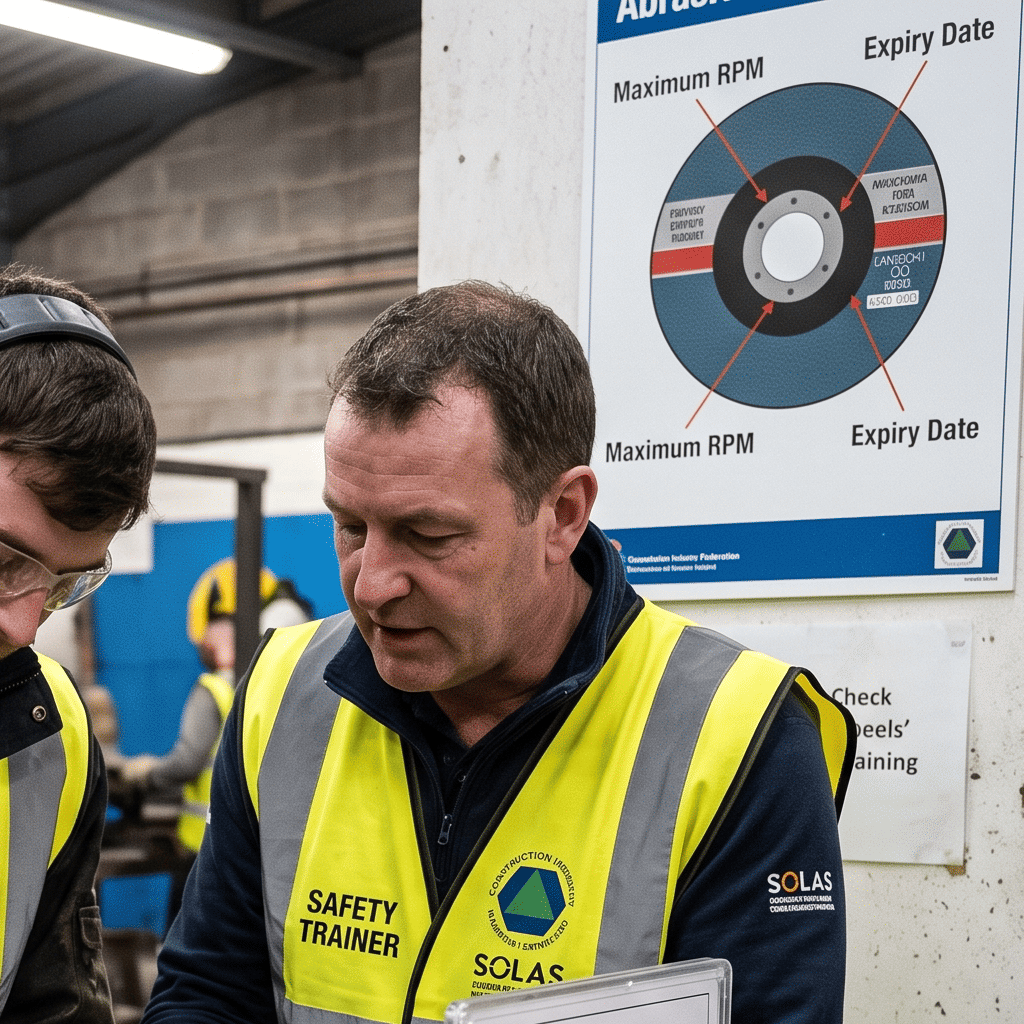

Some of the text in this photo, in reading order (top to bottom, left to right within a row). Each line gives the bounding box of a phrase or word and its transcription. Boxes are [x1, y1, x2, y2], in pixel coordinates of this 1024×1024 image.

[864, 17, 995, 61] Expiry Date
[614, 56, 764, 103] Maximum RPM
[606, 432, 754, 463] Maximum RPM
[851, 418, 979, 450] Expiry Date
[831, 686, 892, 706] Check
[856, 718, 910, 738] eels’
[854, 751, 918, 775] aining
[766, 870, 833, 894] SOLAS
[307, 889, 398, 925] SAFETY
[299, 918, 400, 958] TRAINER
[473, 953, 565, 984] SOLAS
